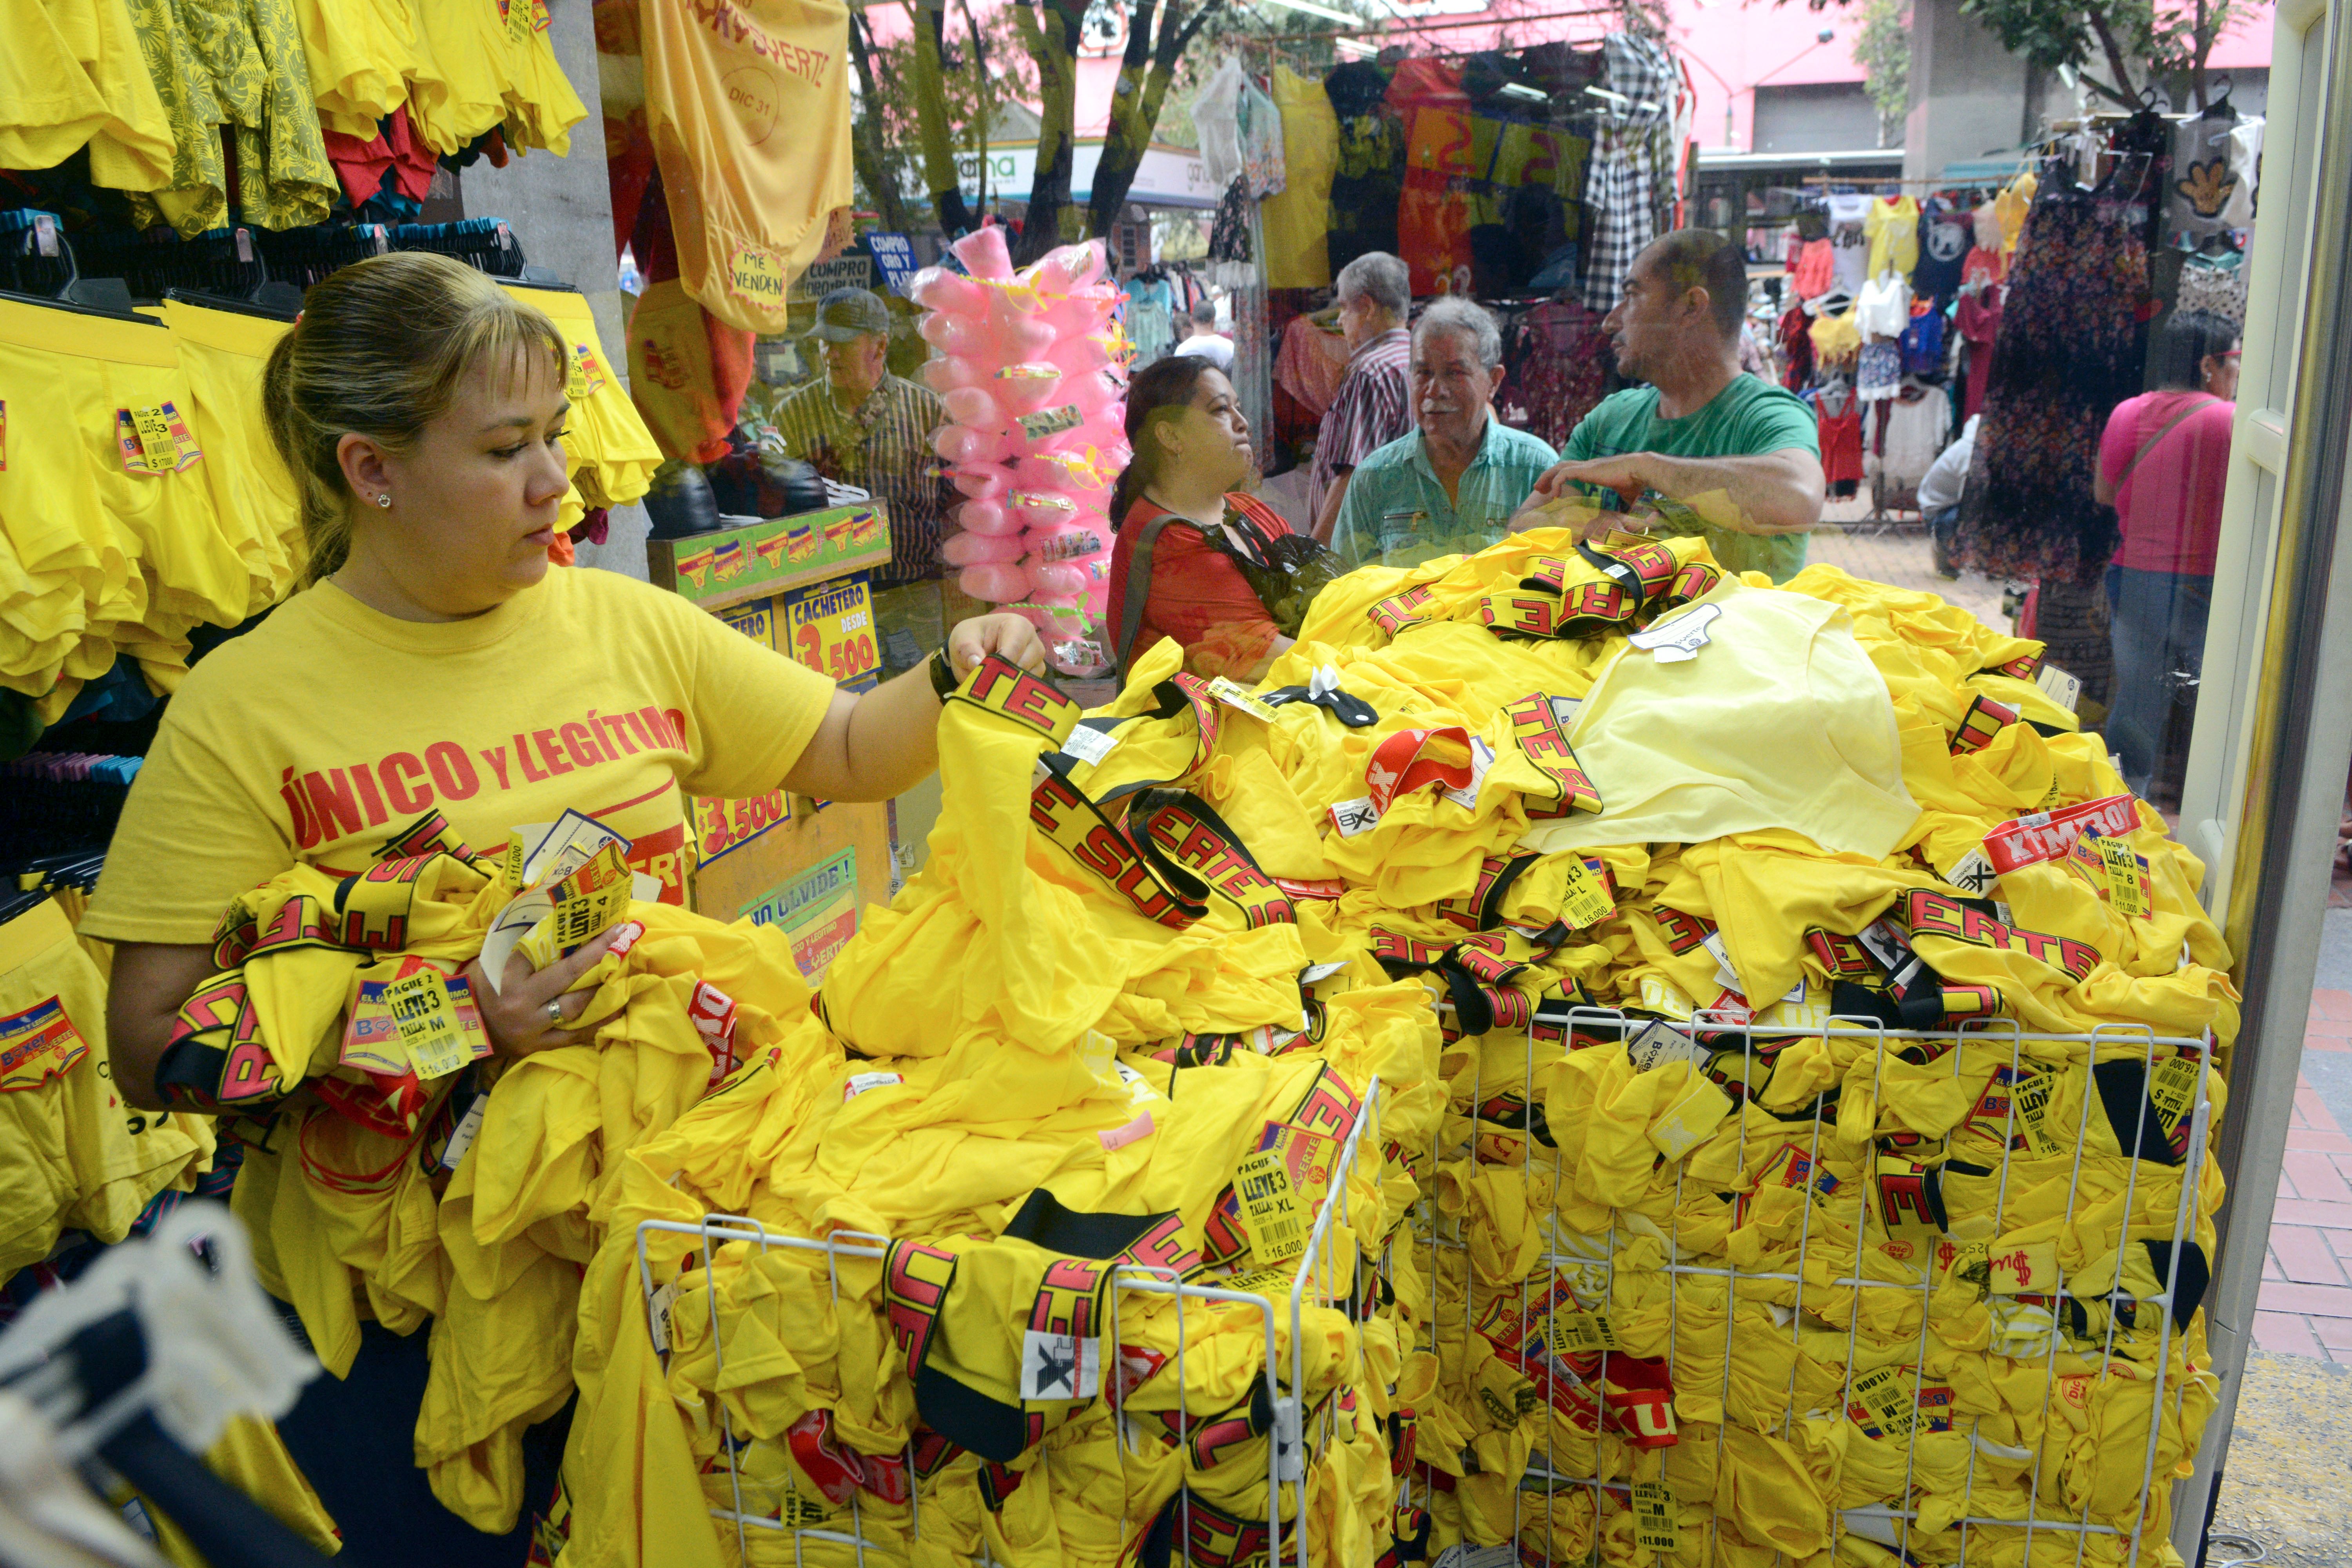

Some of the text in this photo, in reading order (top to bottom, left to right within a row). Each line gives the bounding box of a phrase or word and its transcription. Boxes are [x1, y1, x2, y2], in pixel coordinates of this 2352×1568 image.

[728, 87, 770, 116] DIC 31
[870, 236, 909, 252] COMPRO
[744, 253, 764, 270] ME
[810, 260, 866, 278] COMPRO
[881, 255, 911, 269] ORO Y
[733, 272, 782, 296] VENDEN
[805, 279, 828, 297] ORO
[138, 419, 168, 434] LLEVE 3
[795, 585, 864, 626] CACHETERO
[841, 610, 868, 633] DESDE
[280, 705, 690, 850] ÚNICO Y LEGÍTIMO
[1335, 802, 1371, 815] XTREMBOY
[1951, 856, 1981, 886] XTREMBOY
[2127, 873, 2134, 885] 8
[777, 865, 839, 918] OLVIDE
[1579, 885, 1587, 894] L
[1584, 906, 1608, 924] 16.000
[2118, 900, 2138, 914] 11.000
[791, 943, 805, 956] NICO
[385, 978, 423, 998] PAGUE
[361, 994, 374, 1002] EL
[391, 990, 441, 1024] LLEVE 3
[429, 1016, 446, 1032] M
[2169, 1058, 2195, 1070] 16.000
[2014, 1078, 2045, 1095] PAGUE
[2154, 1089, 2164, 1098] S
[2025, 1108, 2045, 1124] TALLA
[1241, 1169, 1287, 1203] LLEVE 3
[1278, 1199, 1295, 1214] XL
[1271, 1240, 1303, 1259] 16.000
[1881, 1405, 1898, 1419] M
[1663, 1491, 1670, 1501] 3
[1653, 1503, 1666, 1517] M
